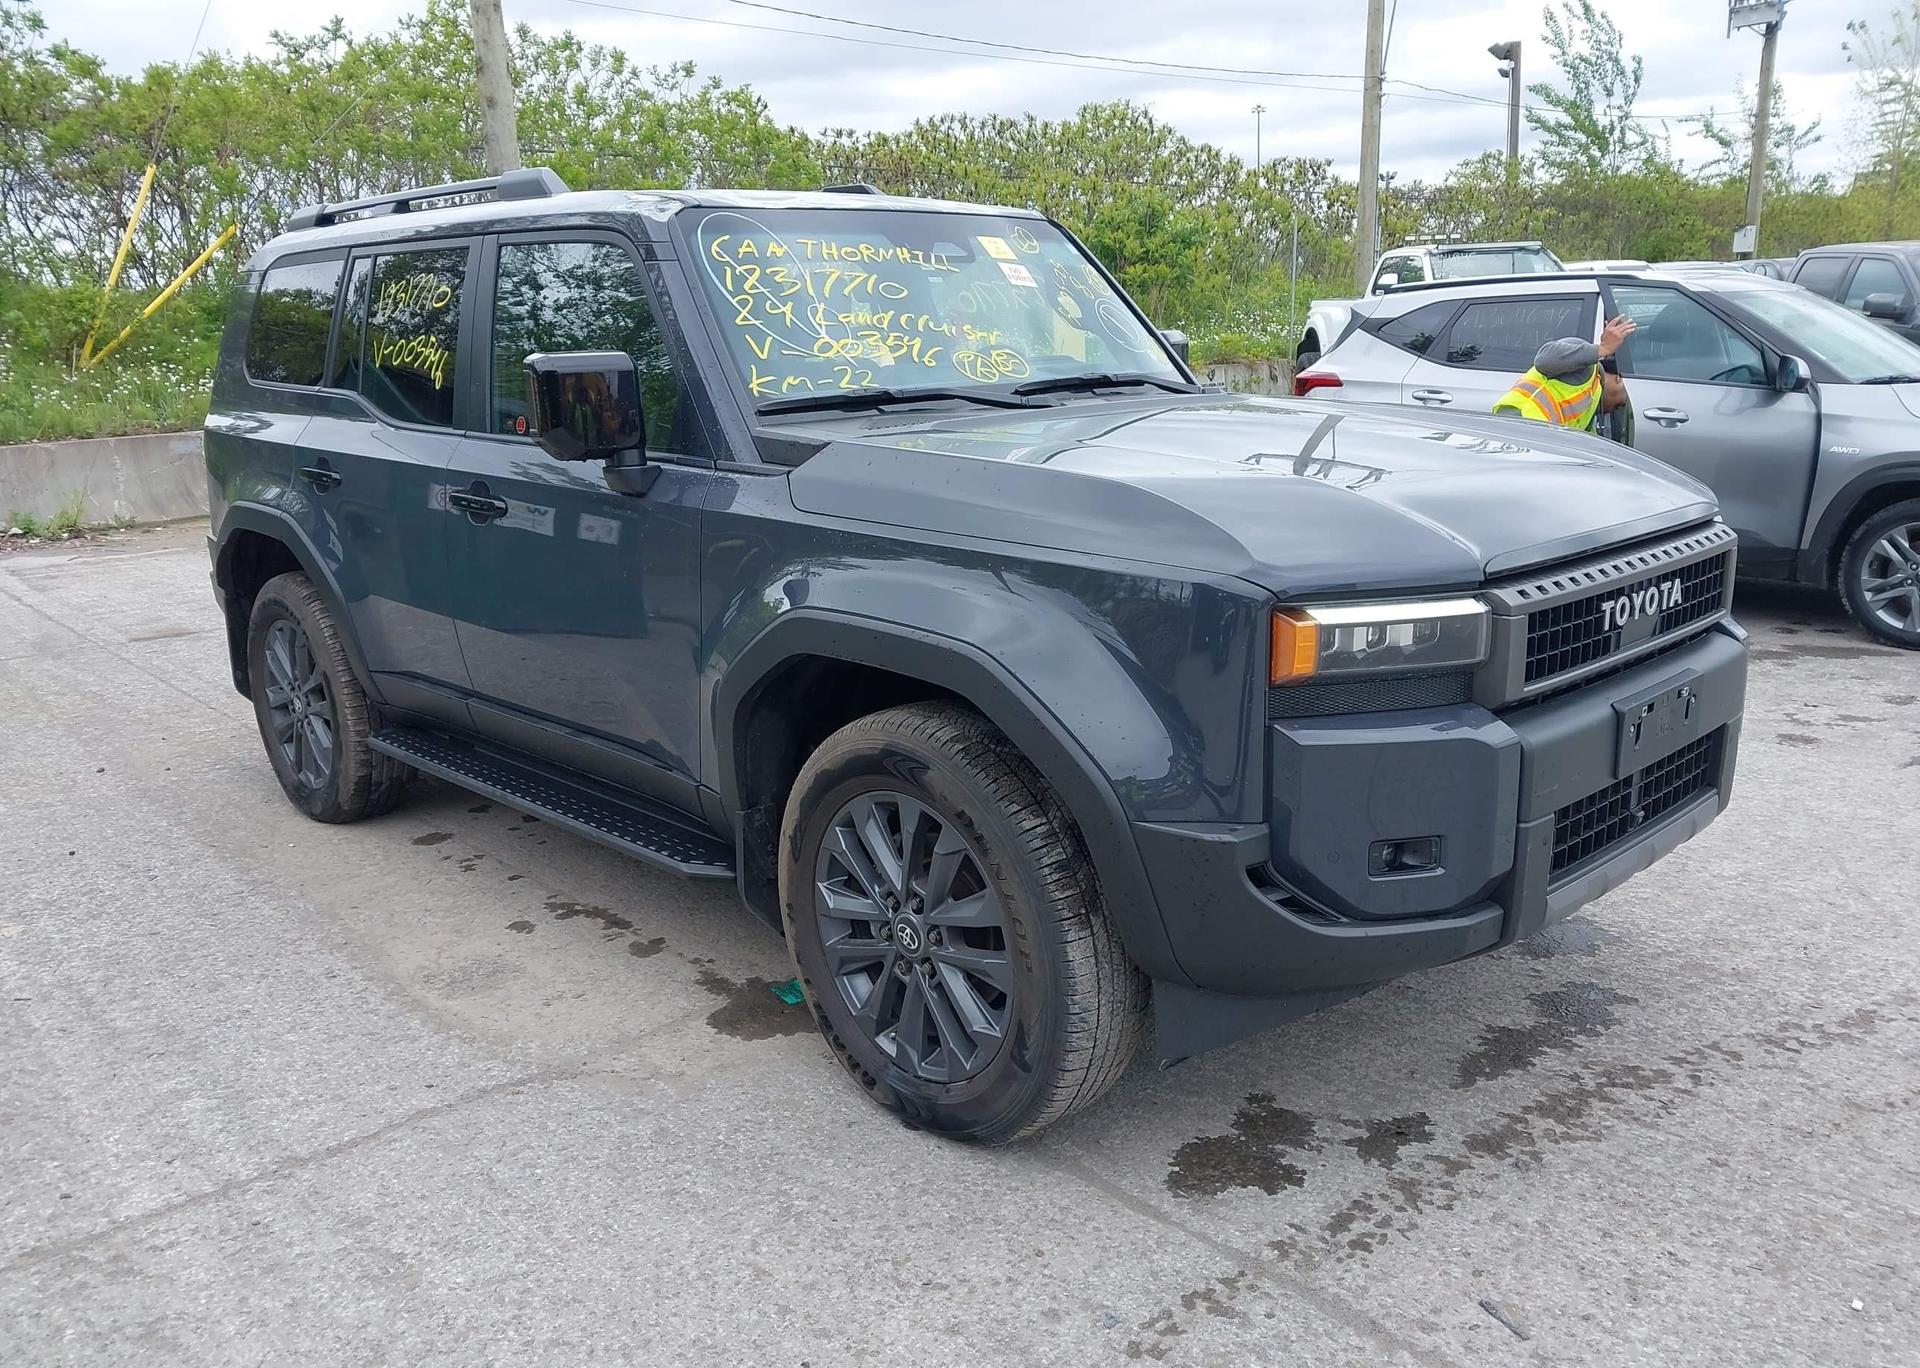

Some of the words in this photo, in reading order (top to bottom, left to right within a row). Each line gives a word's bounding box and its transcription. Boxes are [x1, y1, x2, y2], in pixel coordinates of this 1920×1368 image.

[796, 239, 960, 272] THORNHILL
[1829, 445, 1862, 455] AWD
[1601, 578, 1683, 631] TOYOTA
